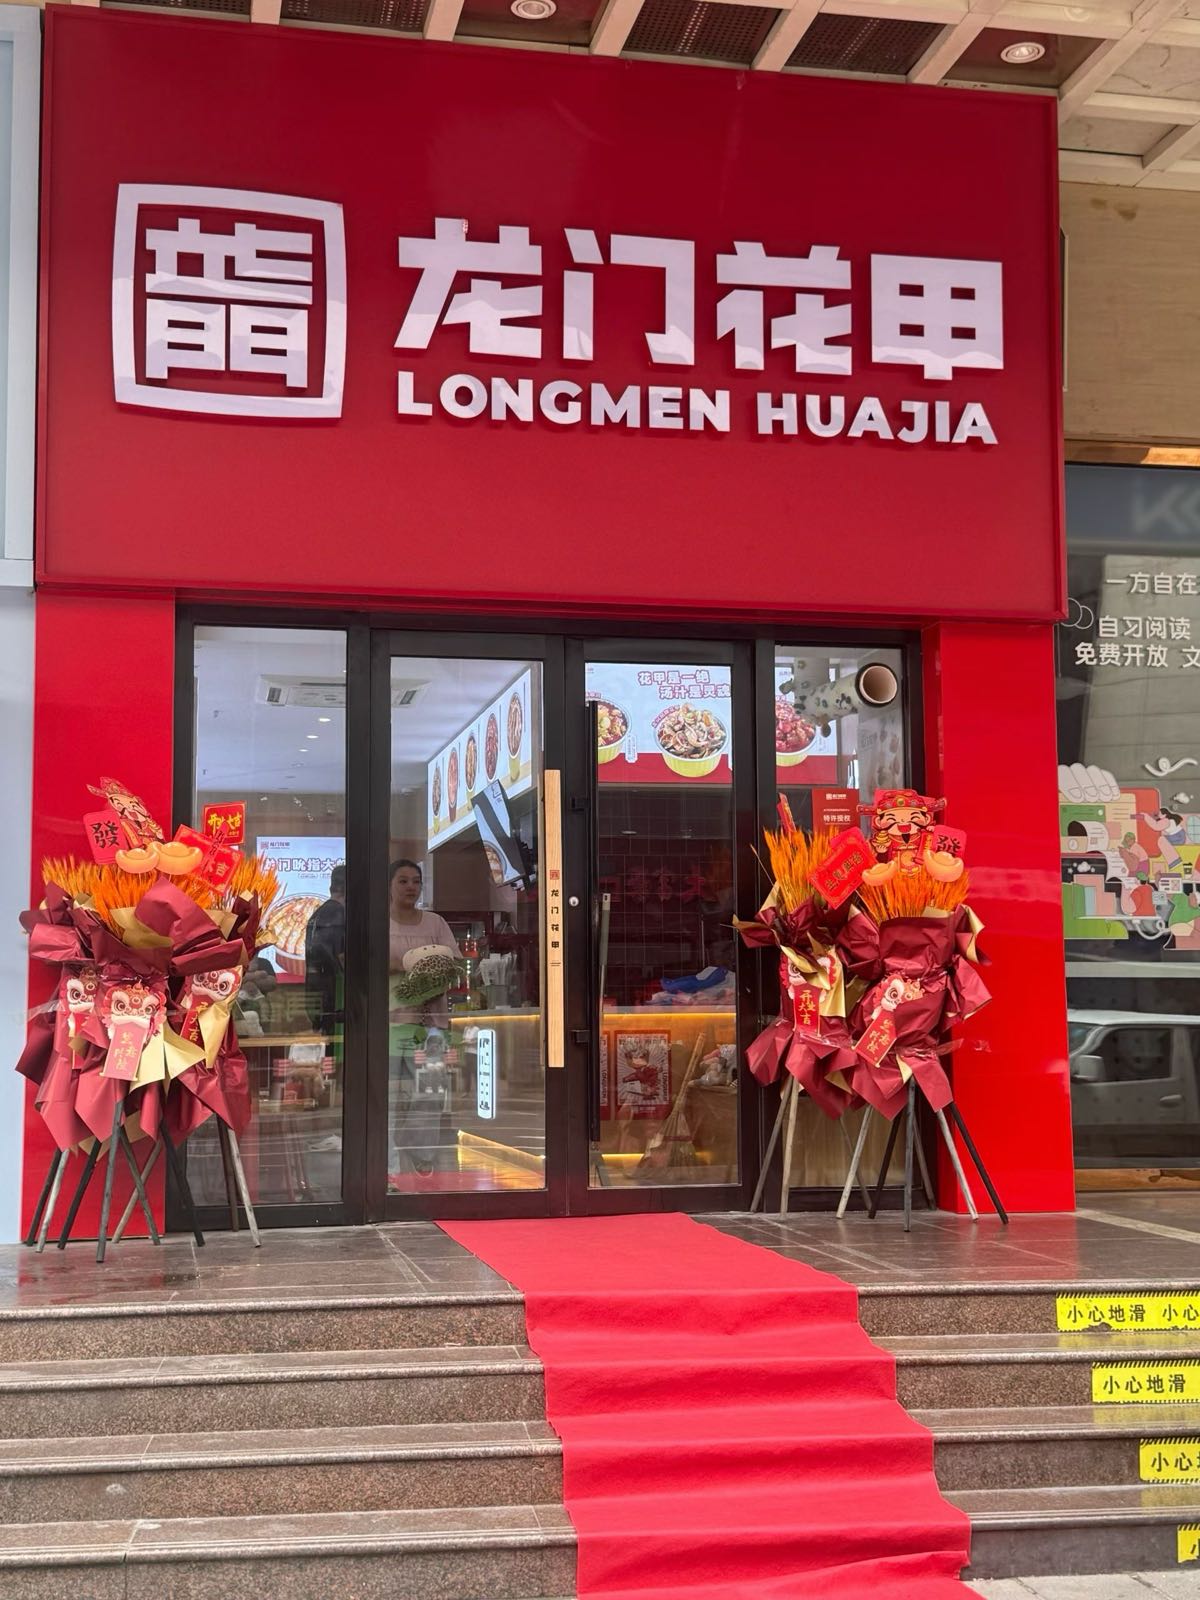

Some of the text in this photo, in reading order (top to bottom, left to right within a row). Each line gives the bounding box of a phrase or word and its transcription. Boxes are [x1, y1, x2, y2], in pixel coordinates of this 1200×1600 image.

[394, 217, 1004, 381] 龙门花甲
[397, 370, 999, 446] LONGMEN HUAJIA
[1105, 571, 1199, 595] 一方自在
[1098, 615, 1192, 640] 自习阅读
[1074, 642, 1169, 668] 免费开放
[823, 814, 852, 822] 特许授权
[91, 820, 120, 849] 發
[550, 888, 560, 949] 龙门花甲
[1067, 1304, 1199, 1323] 小心地滑 小心
[1103, 1374, 1186, 1394] 小心地滑
[1151, 1451, 1200, 1473] 小心
